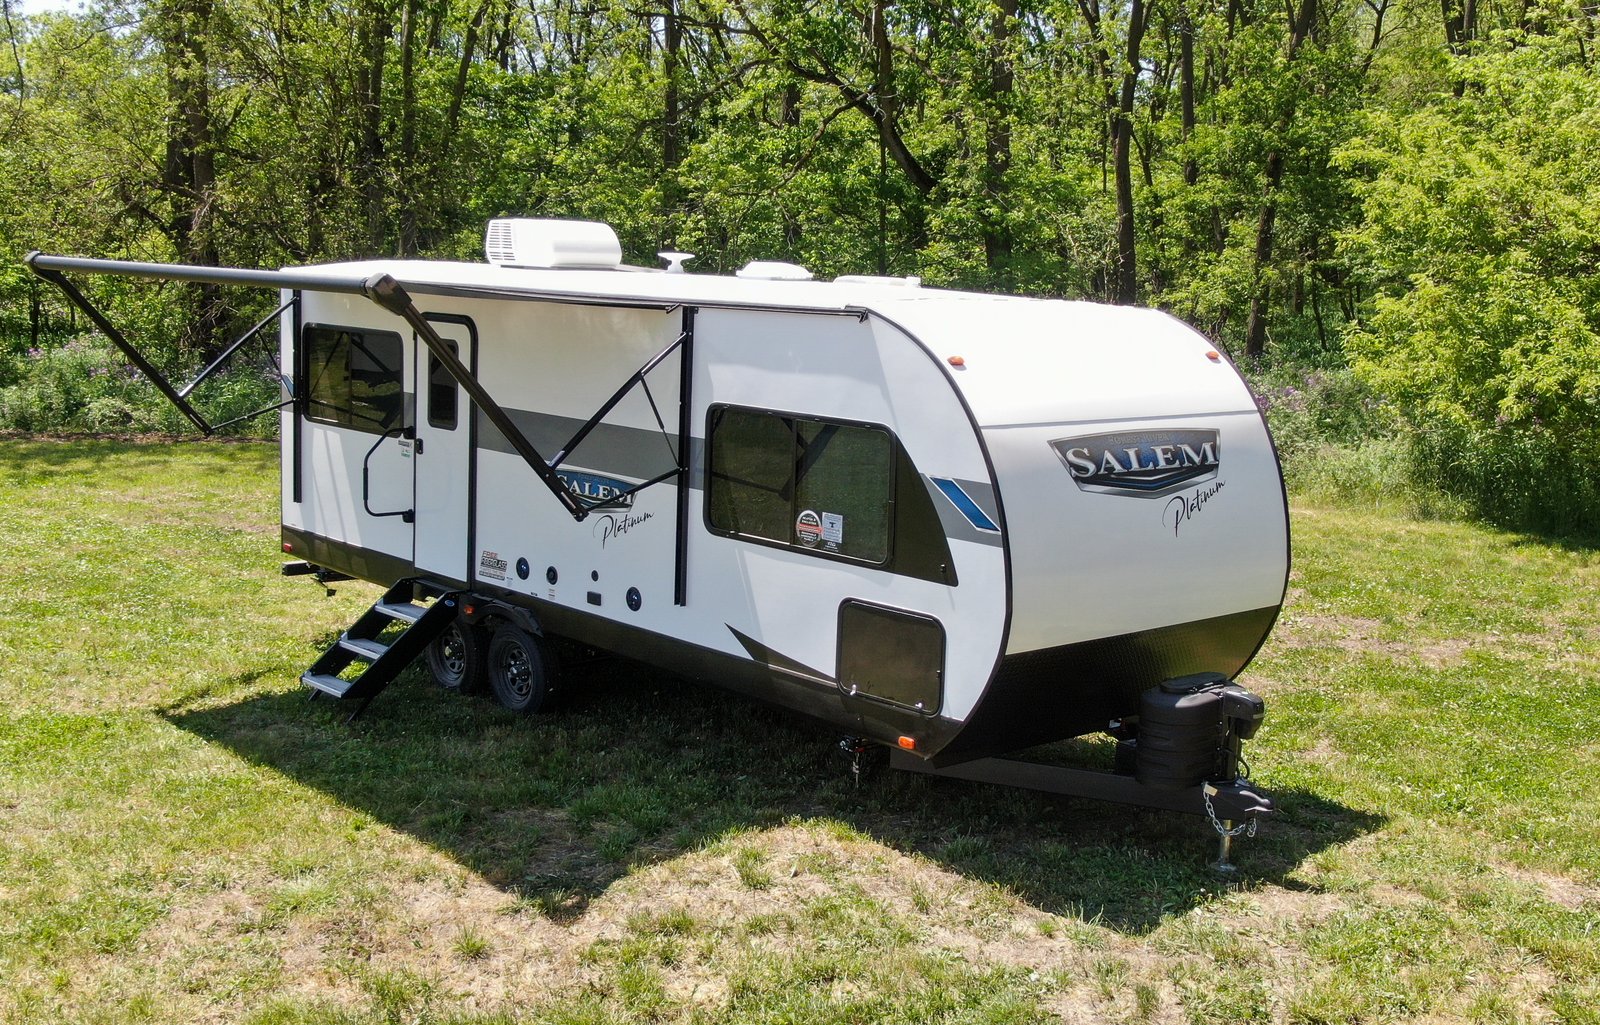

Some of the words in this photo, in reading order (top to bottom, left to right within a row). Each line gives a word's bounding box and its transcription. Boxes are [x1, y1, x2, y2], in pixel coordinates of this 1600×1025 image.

[1066, 441, 1219, 478] SALEM
[1162, 481, 1226, 537] Platinum
[593, 512, 654, 549] Platinum
